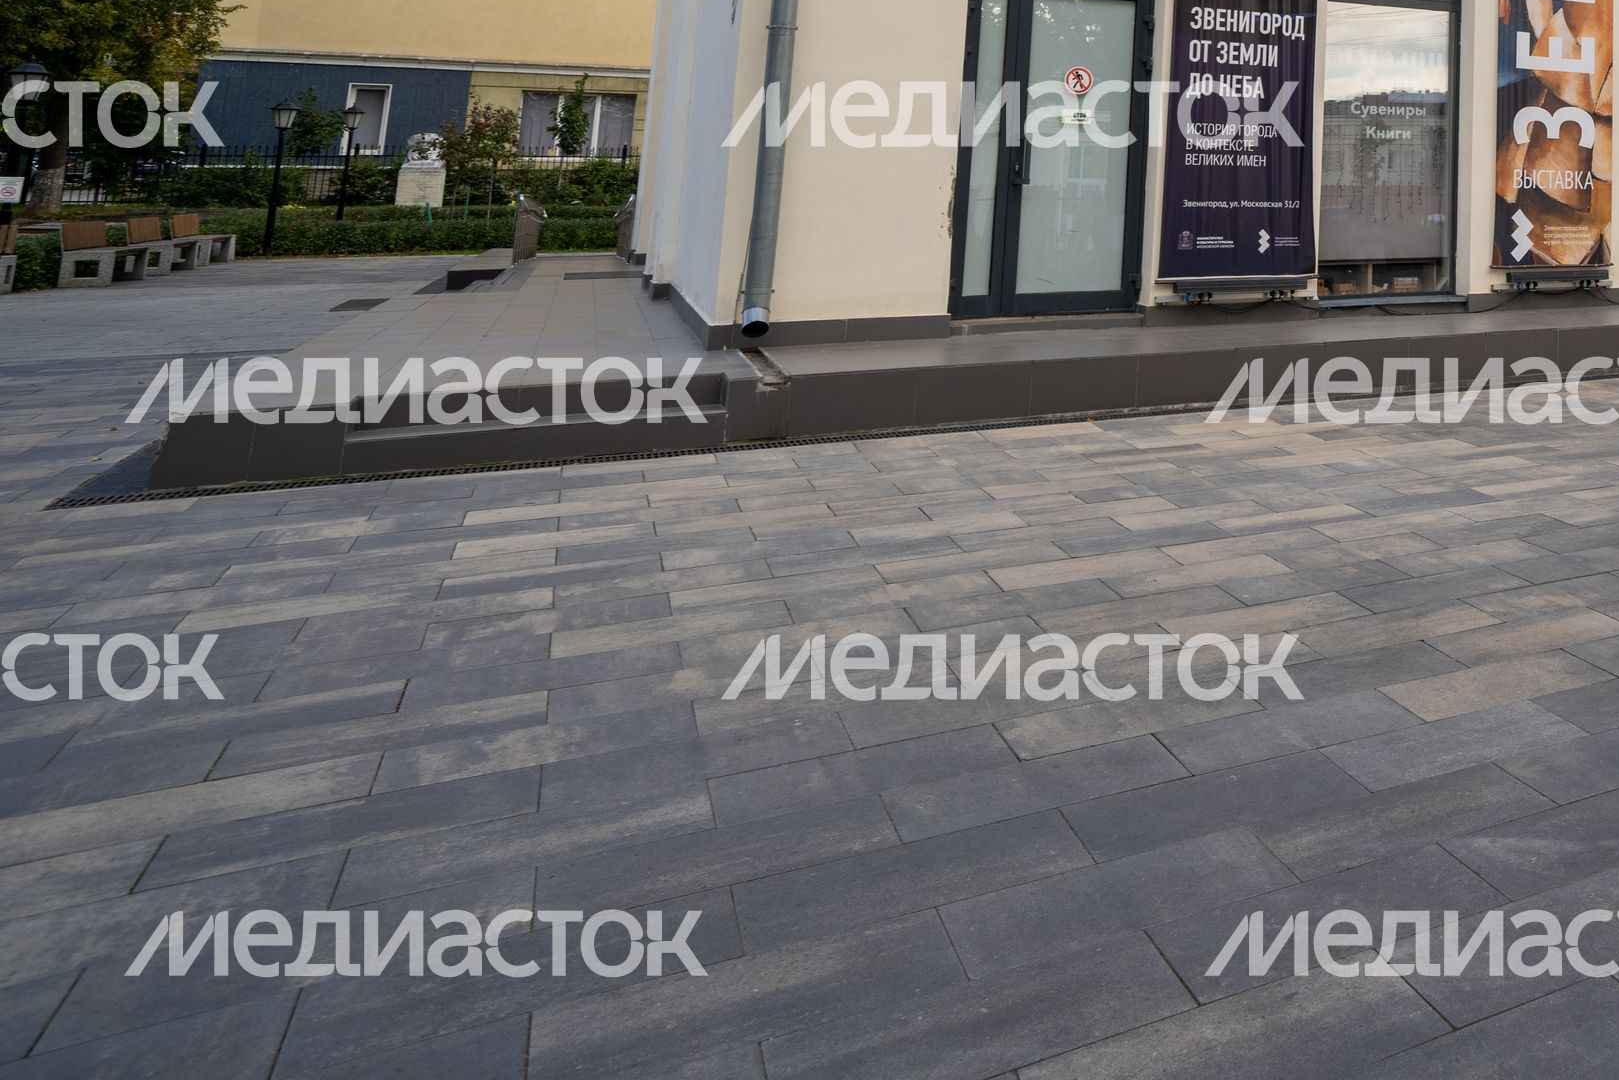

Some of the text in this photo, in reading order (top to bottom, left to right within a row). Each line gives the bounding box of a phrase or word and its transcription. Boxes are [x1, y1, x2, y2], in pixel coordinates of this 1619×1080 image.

[1190, 6, 1305, 41] ЗВЕНИГОРОД
[1189, 39, 1278, 68] ОТ ЗЕМЛИ
[1186, 72, 1265, 99] ДО НЕБА
[1351, 101, 1426, 120] Сувениры
[1186, 122, 1278, 138] ИСТОРИЯ ГОРОДА
[1366, 126, 1411, 140] Книги
[1186, 138, 1254, 152] В КОНТЕКСТЕ
[1185, 153, 1266, 167] ВЕЛИКИХ ИМЕН
[1513, 169, 1594, 190] ВЫСТАВКА
[1183, 199, 1301, 209] Звенигород, ул. Московская 31/2
